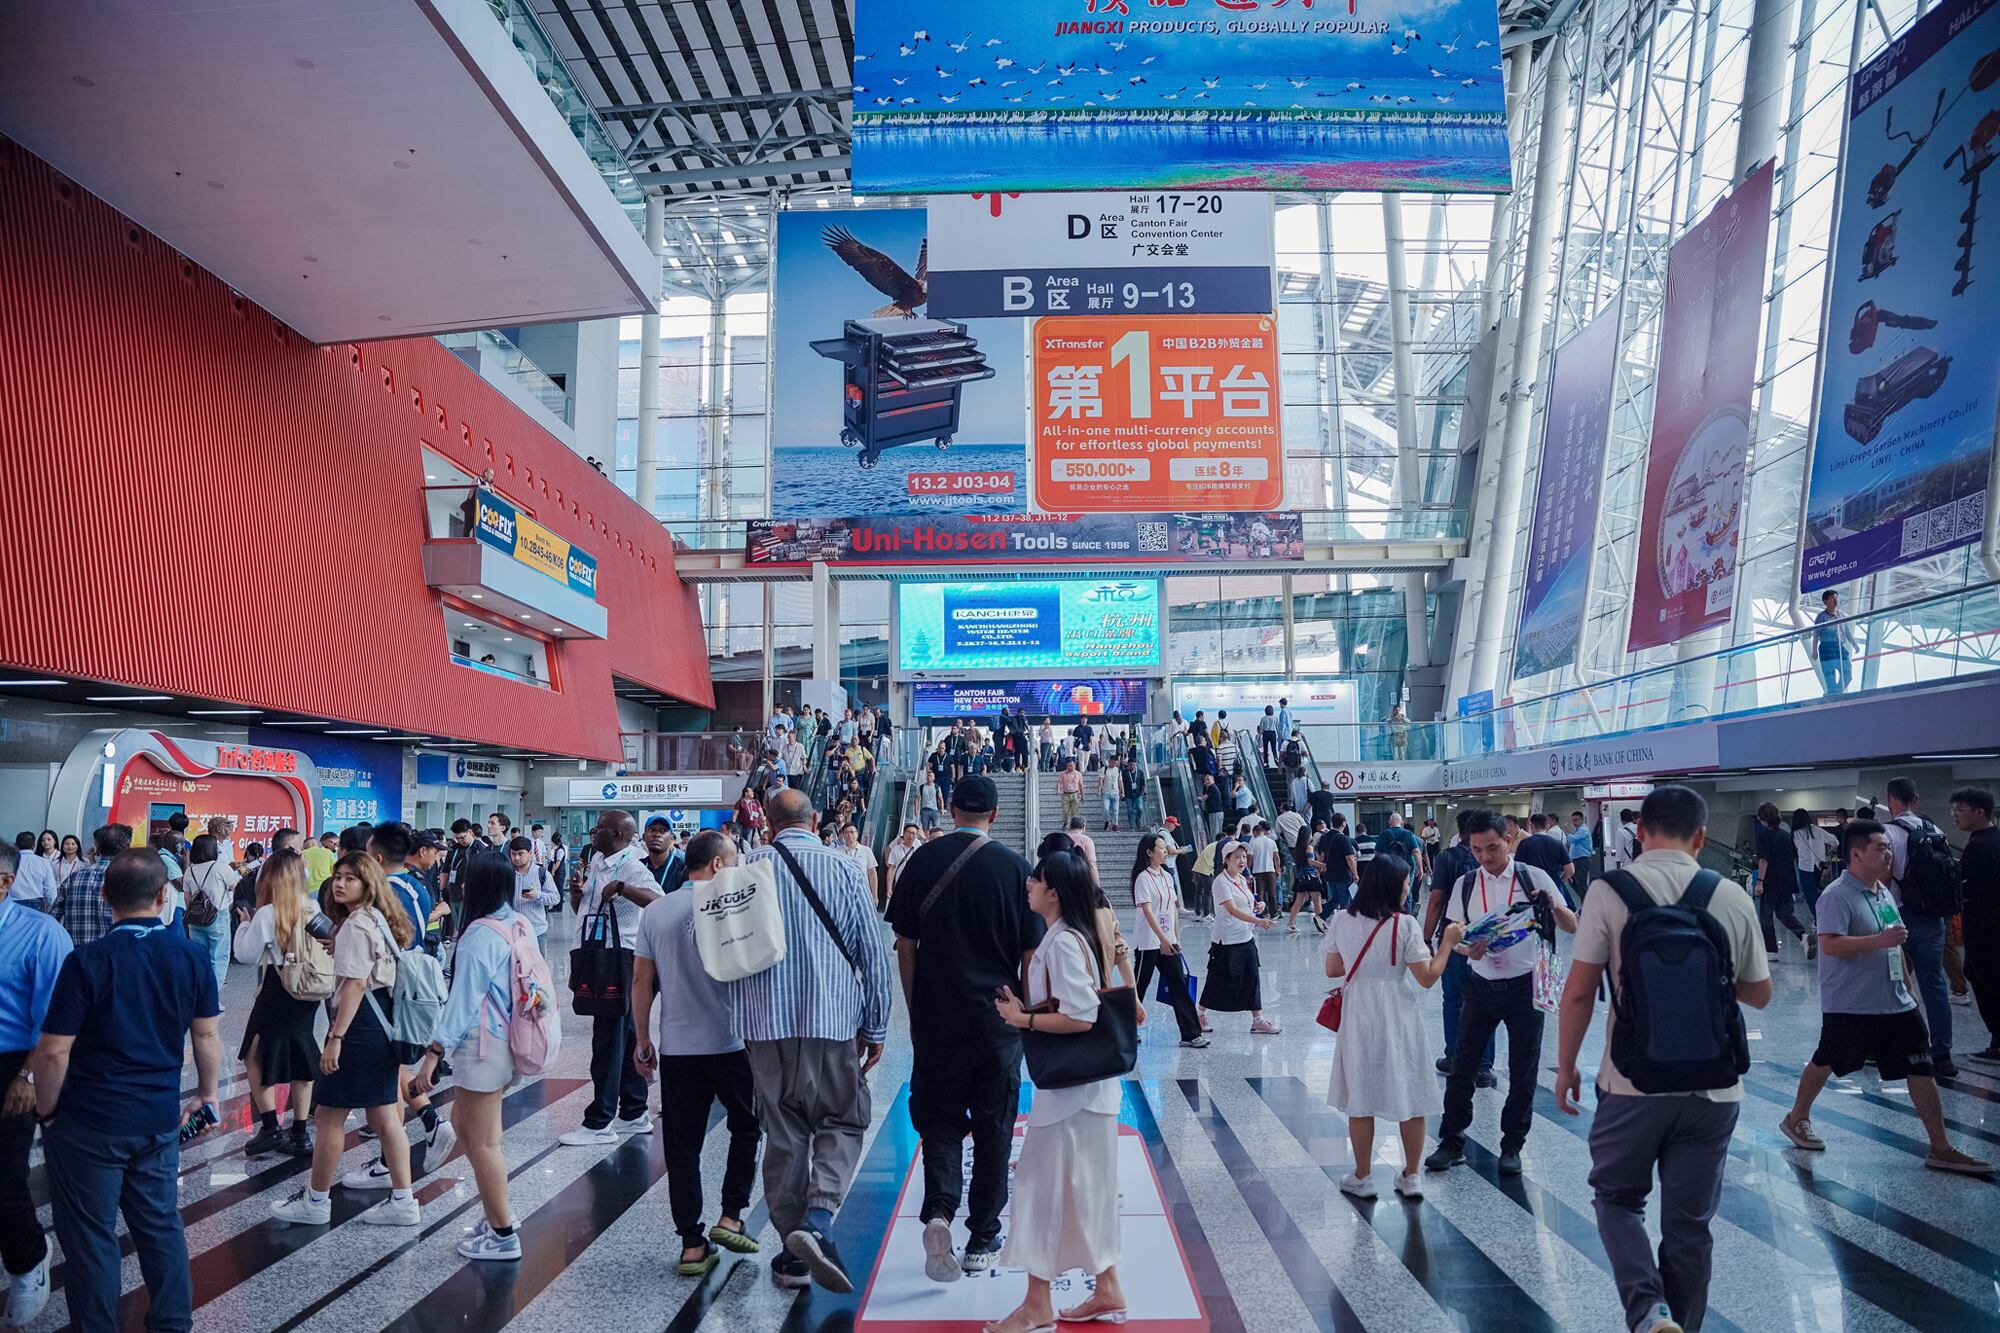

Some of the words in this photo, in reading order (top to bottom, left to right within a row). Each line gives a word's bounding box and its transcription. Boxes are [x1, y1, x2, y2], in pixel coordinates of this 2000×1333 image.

[1055, 21, 1124, 36] JIANGXI
[1129, 20, 1220, 35] PRODUCTS,
[1226, 20, 1309, 34] GLOBALLY
[1313, 20, 1390, 34] POPULAR
[1129, 195, 1150, 204] Hall
[1130, 205, 1150, 214] 展厅
[1067, 214, 1091, 240] D
[1099, 213, 1124, 222] Area
[1131, 219, 1166, 228] Canton
[1169, 219, 1188, 228] Fair
[1101, 224, 1118, 239] 区
[1131, 230, 1188, 239] Convention
[1190, 230, 1224, 239] Center
[1132, 243, 1189, 256] 广交会堂
[1003, 276, 1034, 311] B
[1045, 275, 1079, 287] Area
[1087, 283, 1114, 295] Hall
[1048, 290, 1071, 310] 区
[1087, 297, 1114, 309] 展厅
[1045, 339, 1105, 350] XTransfer
[1162, 338, 1264, 349] 中国B2B外贸金融
[1043, 425, 1111, 437] All-in-one
[1115, 424, 1212, 438] multi-currency
[1216, 425, 1274, 436] accounts
[1873, 436, 1901, 455] Garden
[1903, 415, 1946, 440] Machinery
[1056, 440, 1075, 450] for
[1079, 439, 1143, 450] effortless
[1147, 439, 1189, 452] global
[1193, 439, 1262, 451] payments!
[1871, 453, 1892, 469] LINYI
[1900, 439, 1925, 457] CHINA
[1066, 463, 1136, 477] 550,000+
[1194, 461, 1244, 477] 连续8年
[911, 477, 948, 490] 13.2
[952, 475, 1011, 489] J03-04
[852, 528, 1006, 551] Uni-Hosen
[1012, 532, 1068, 550] Tools
[1072, 542, 1101, 550] SINCE
[1105, 541, 1130, 549] 1996
[1807, 559, 1857, 581] www.grepo.cn
[956, 610, 1006, 618] KANCH
[1101, 613, 1153, 628] 杭州
[1065, 650, 1108, 658] export
[1112, 649, 1151, 657] brand
[217, 746, 248, 769] Info
[1593, 751, 1614, 767] BANK
[1615, 750, 1625, 764] OF
[1626, 747, 1654, 763] CHINA
[1359, 771, 1401, 783] 中国银行
[1470, 771, 1482, 780] BANK
[1490, 767, 1508, 777] CHINA
[621, 783, 689, 793] 中国建设银行
[244, 815, 293, 832] 互利天下
